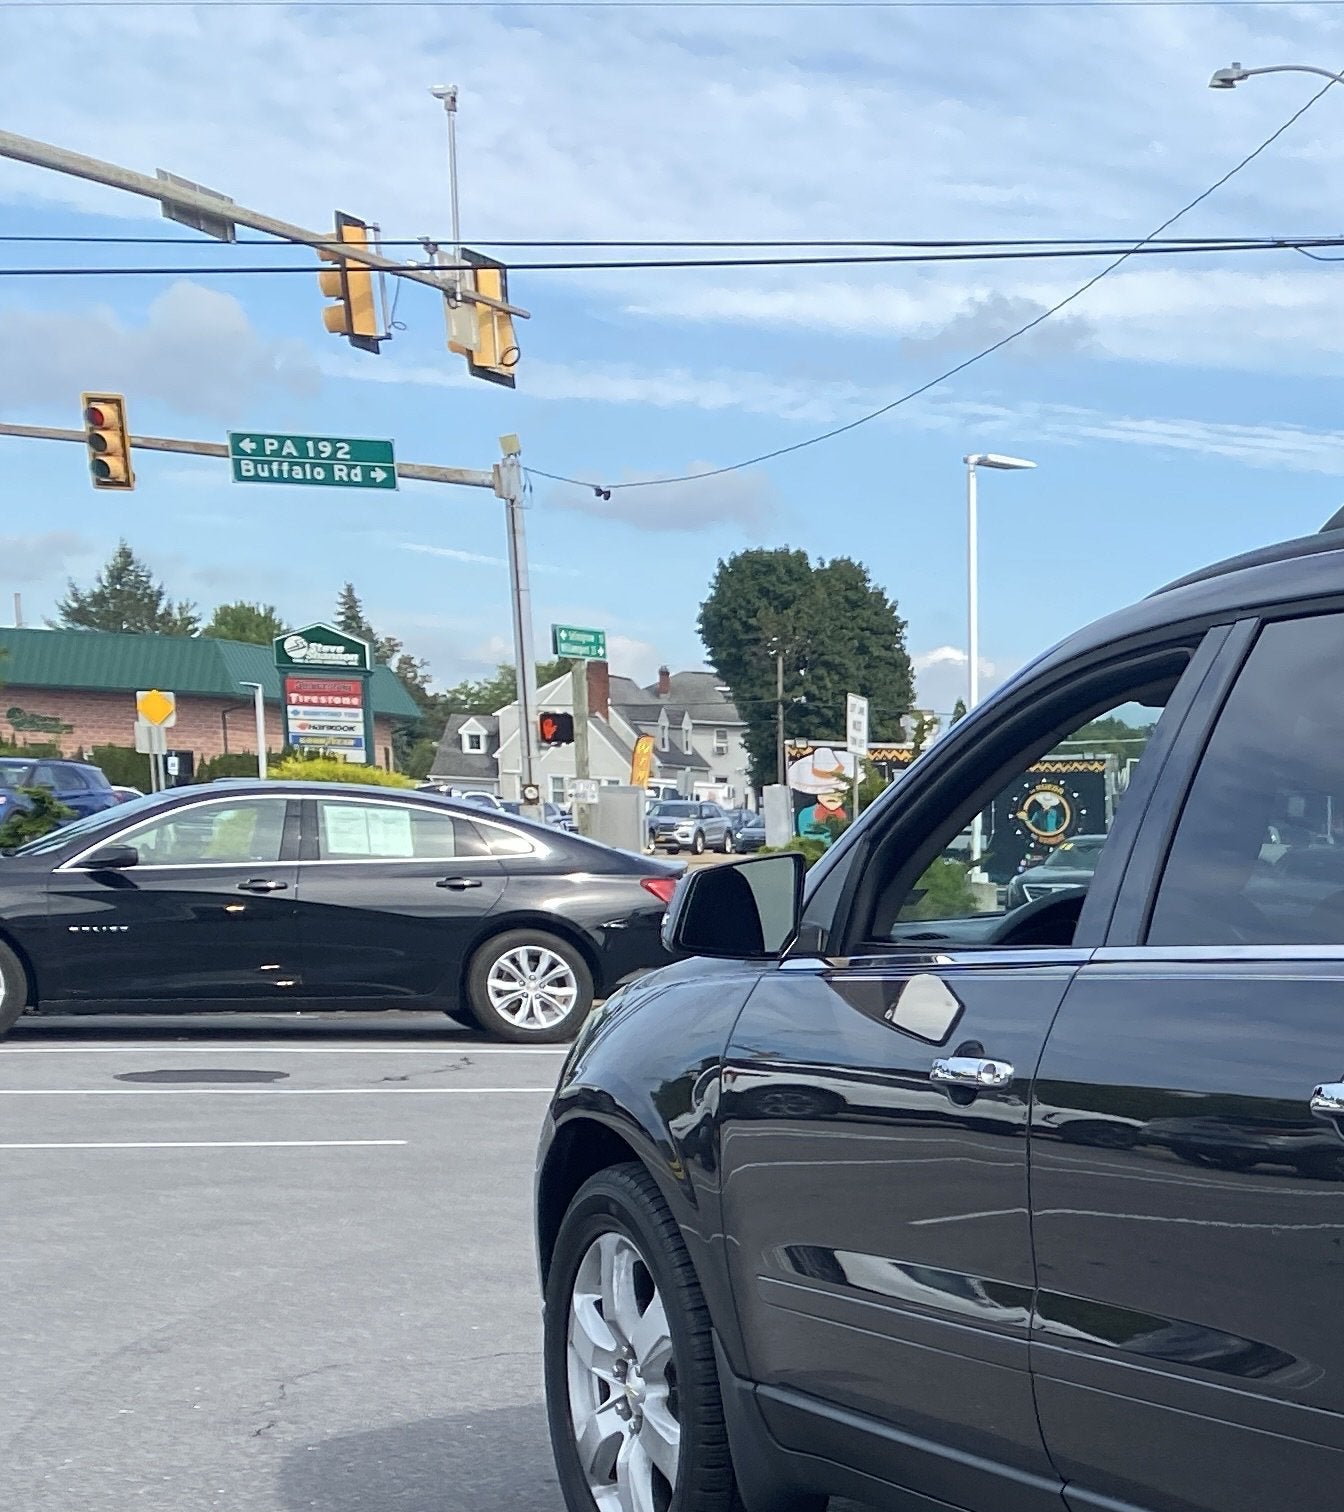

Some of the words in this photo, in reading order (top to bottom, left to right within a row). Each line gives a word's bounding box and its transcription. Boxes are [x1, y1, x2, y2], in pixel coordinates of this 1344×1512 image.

[264, 438, 299, 457] PA
[306, 440, 351, 459] 192
[240, 459, 325, 480] Buffalo
[333, 464, 363, 482] Rd
[289, 692, 359, 706] Firestone
